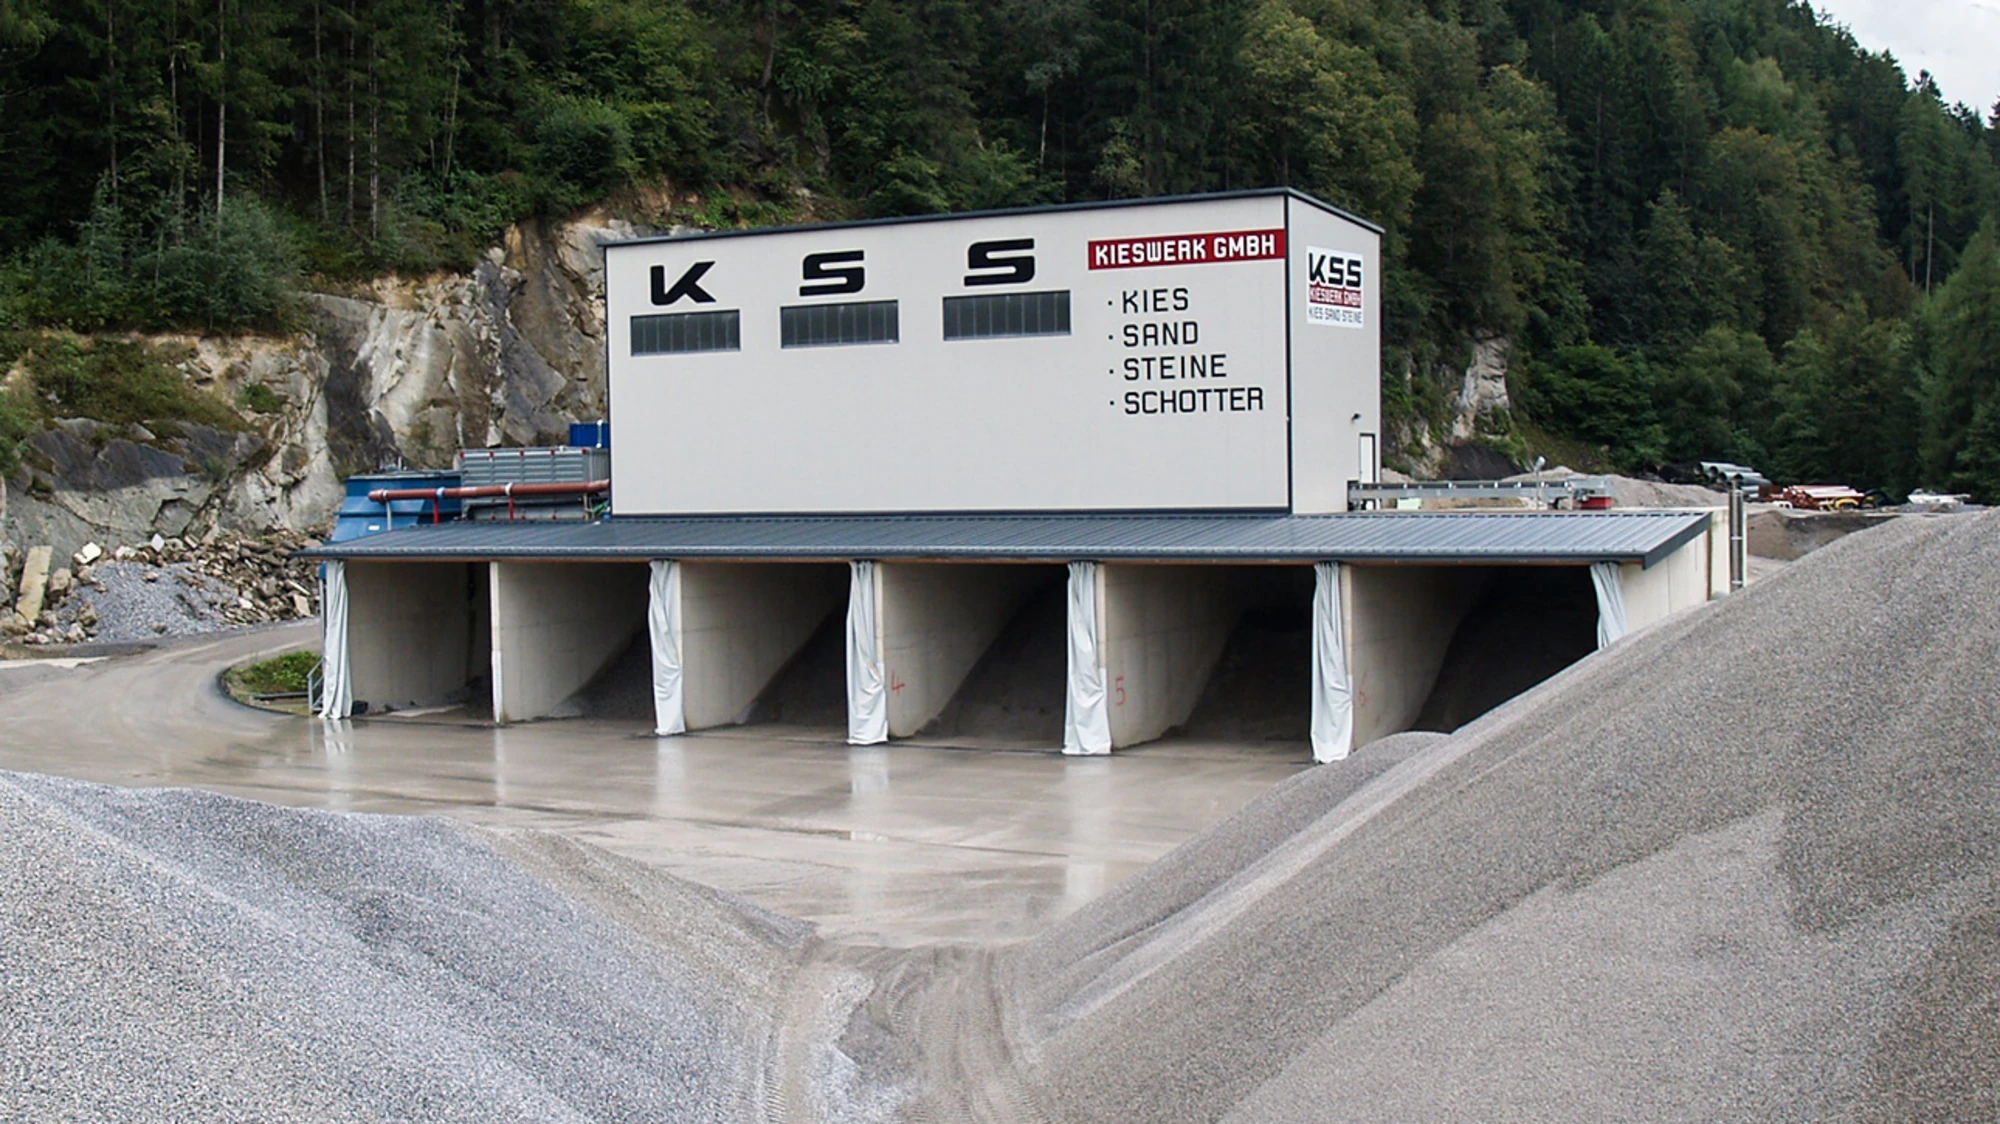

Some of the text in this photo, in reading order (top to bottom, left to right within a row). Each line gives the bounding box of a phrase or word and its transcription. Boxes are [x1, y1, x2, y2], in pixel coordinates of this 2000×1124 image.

[1094, 233, 1276, 267] KIESWERK GMBH
[1308, 252, 1362, 288] KSS
[1121, 287, 1190, 314] KIES
[1309, 286, 1343, 304] KIESWERK
[1122, 320, 1199, 348] SAND
[1123, 353, 1228, 381] STEINE
[1123, 386, 1264, 415] SCHOTTER
[890, 669, 905, 697] 4
[1114, 675, 1127, 708] 5
